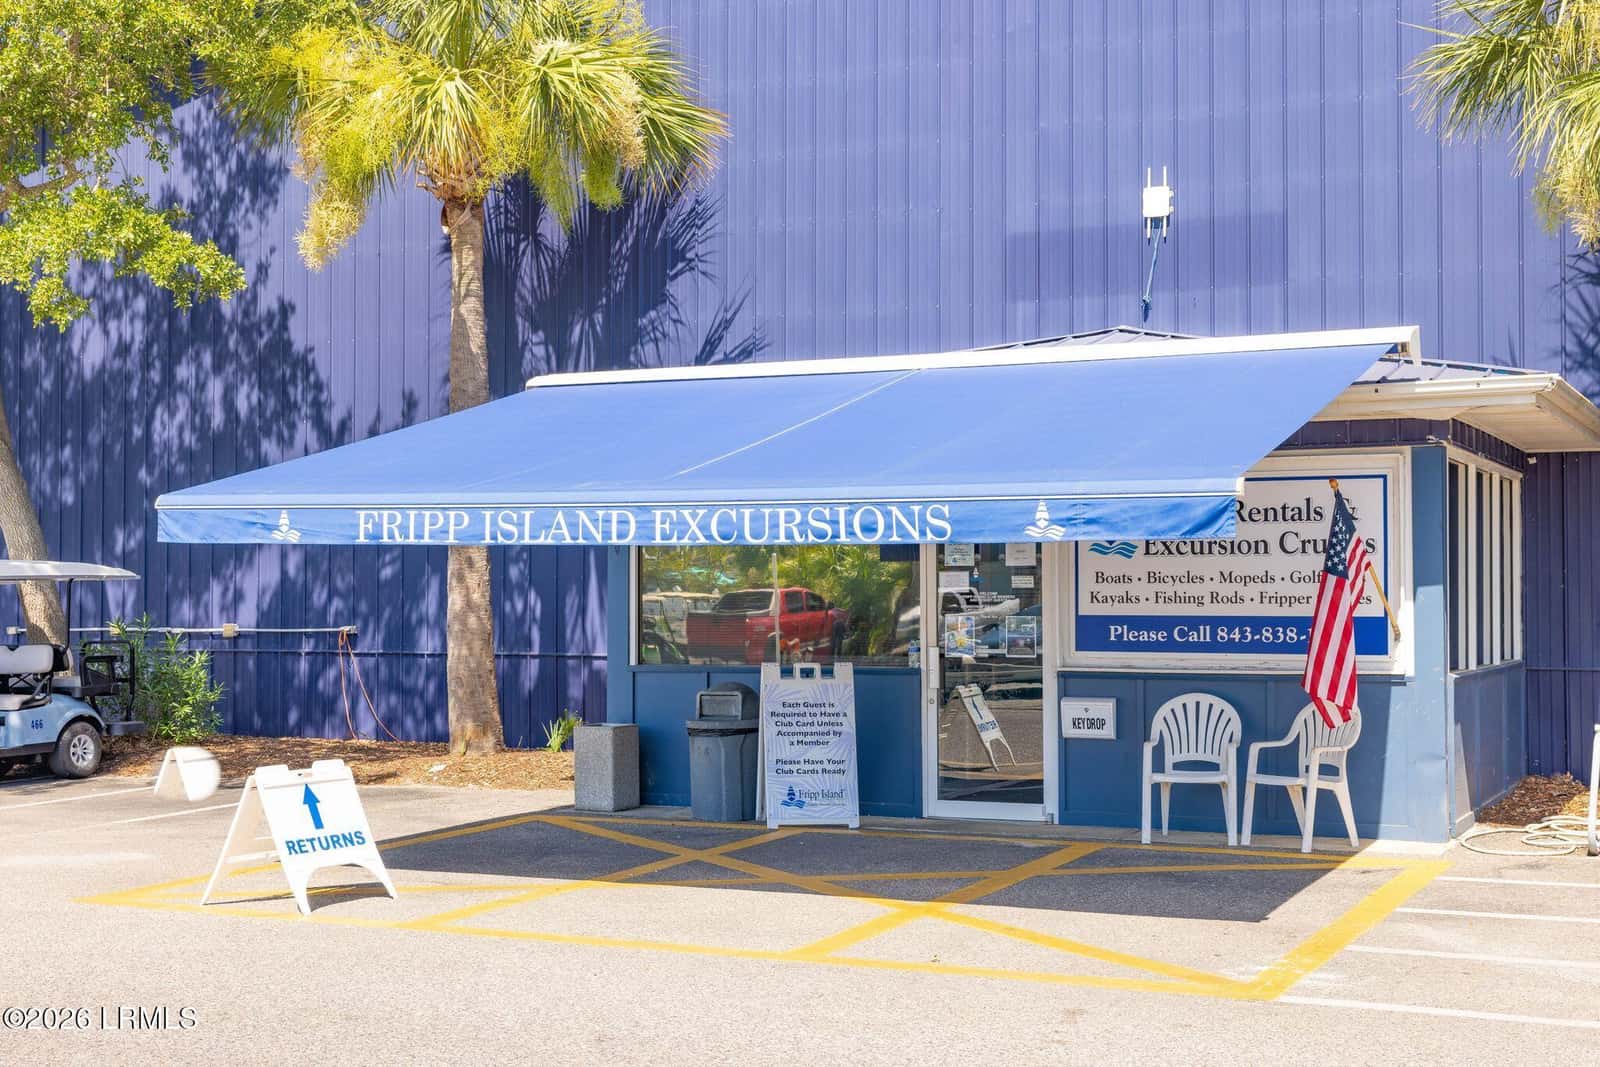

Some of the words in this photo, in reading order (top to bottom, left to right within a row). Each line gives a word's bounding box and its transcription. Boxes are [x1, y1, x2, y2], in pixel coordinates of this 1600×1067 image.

[355, 510, 470, 543] FRIPP
[480, 509, 637, 544] ISLAND
[651, 504, 952, 544] EXCURSIONS
[1143, 539, 1270, 556] Excursion
[1095, 571, 1133, 584] Boats
[1147, 570, 1205, 587] Bicycles
[1219, 570, 1276, 587] Mopeds
[1089, 591, 1141, 607] Kayaks
[1155, 590, 1205, 607] Fishing
[1209, 591, 1245, 604] Rods
[1259, 591, 1313, 607] Fripper
[1109, 625, 1168, 642] Please
[1173, 625, 1211, 642] Call
[771, 711, 807, 719] Required
[777, 730, 831, 738] Accompanied
[833, 730, 842, 738] by
[822, 767, 847, 776] Ready
[285, 831, 366, 855] RETURNS
